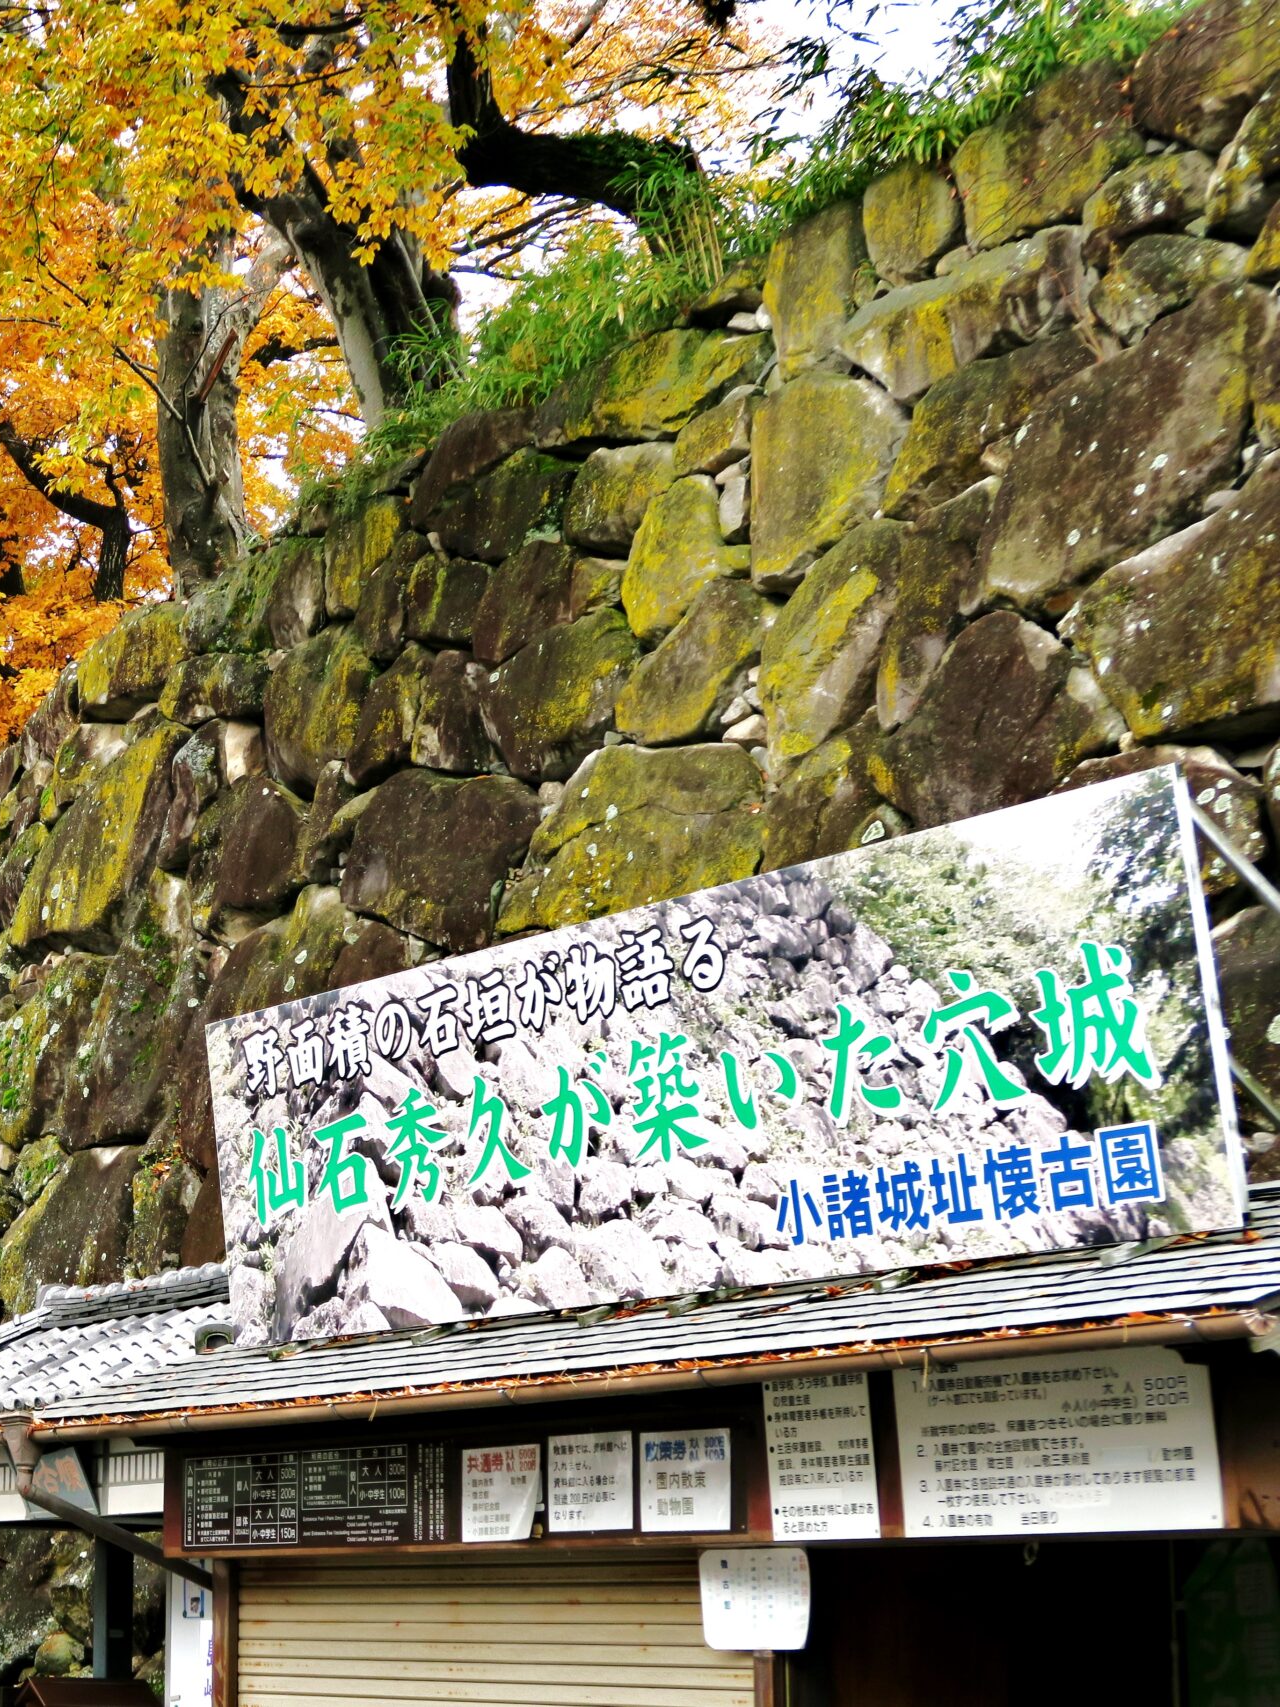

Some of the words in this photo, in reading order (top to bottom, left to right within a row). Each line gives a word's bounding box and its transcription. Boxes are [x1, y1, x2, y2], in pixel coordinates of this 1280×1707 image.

[242, 916, 724, 1097] 野面積の石垣が物語る
[246, 942, 1155, 1226] 仙石秀久が築いた穴城
[776, 1122, 1163, 1245] 小諸城址懐古園
[1144, 1376, 1188, 1391] 500円
[1145, 1391, 1189, 1407] 200円
[656, 1470, 706, 1490] 園内散策
[389, 1488, 406, 1500] 100円
[657, 1496, 694, 1516] 動物園
[280, 1527, 296, 1540] 150円
